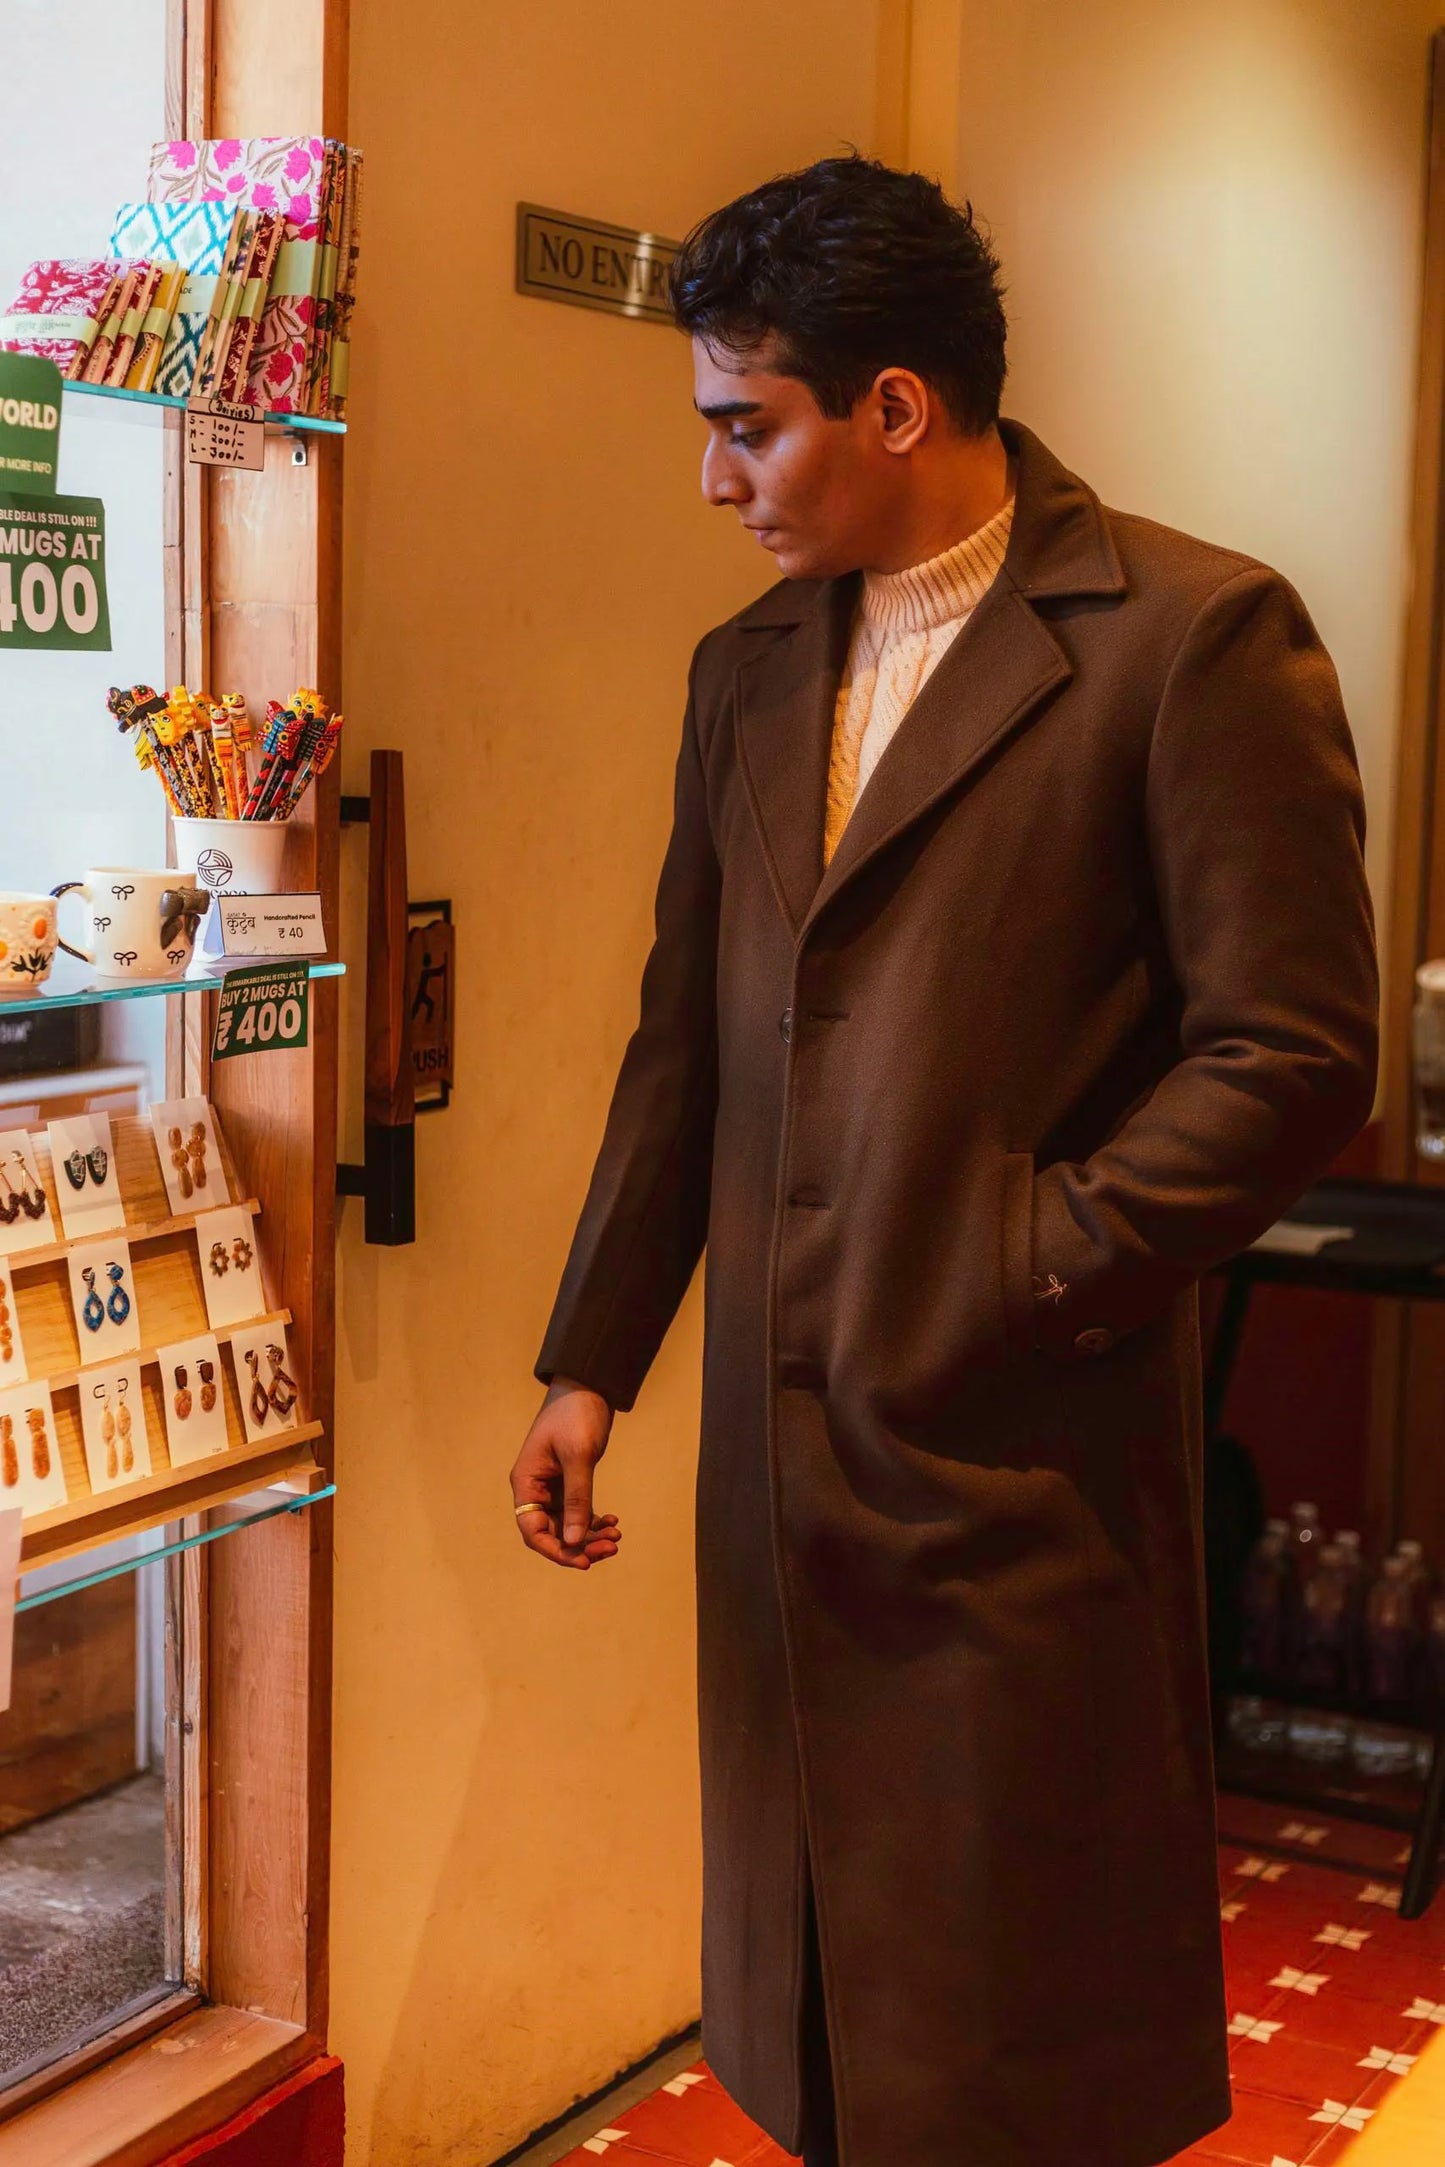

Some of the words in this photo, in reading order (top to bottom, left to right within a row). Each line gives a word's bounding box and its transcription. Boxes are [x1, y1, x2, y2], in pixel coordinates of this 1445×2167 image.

[540, 232, 584, 280] NO
[592, 245, 672, 298] ENTR
[0, 398, 58, 430] ORLD
[7, 458, 32, 471] MORE
[33, 461, 52, 474] INFO
[14, 510, 37, 522] DEAL
[37, 512, 46, 524] IS
[48, 513, 71, 526] STILL
[71, 515, 84, 527] ON
[86, 516, 97, 527] !!!
[0, 527, 67, 559] MUGS
[70, 533, 102, 560] AT
[289, 926, 304, 938] 40
[260, 975, 272, 983] DEAL
[221, 989, 241, 1008] BUY
[241, 987, 250, 1003] 2
[250, 983, 286, 1002] MUGS
[287, 980, 307, 997] AT
[236, 999, 302, 1045] 400
[412, 1046, 449, 1072] USH
